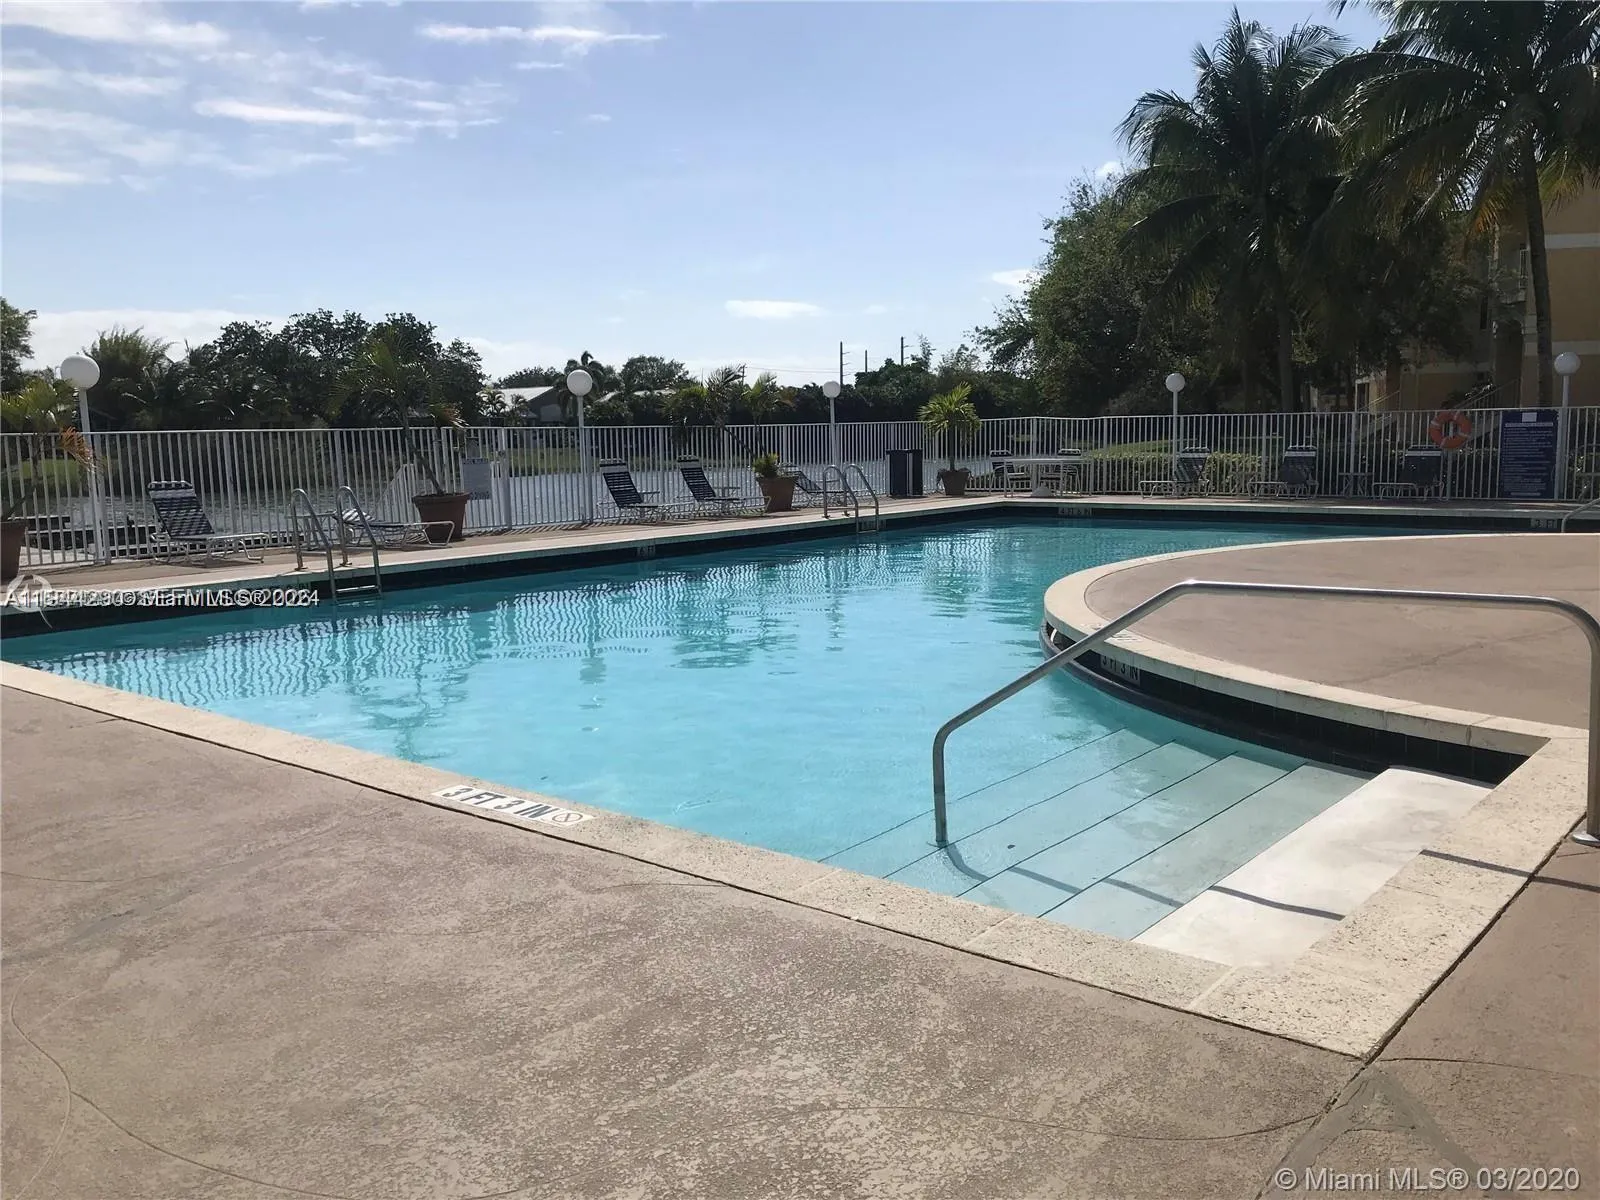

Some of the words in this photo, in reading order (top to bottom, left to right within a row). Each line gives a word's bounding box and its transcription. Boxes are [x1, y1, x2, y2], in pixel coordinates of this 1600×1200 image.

[442, 787, 473, 798] 3
[460, 791, 507, 805] FT
[493, 799, 525, 810] 3
[513, 803, 559, 819] IN
